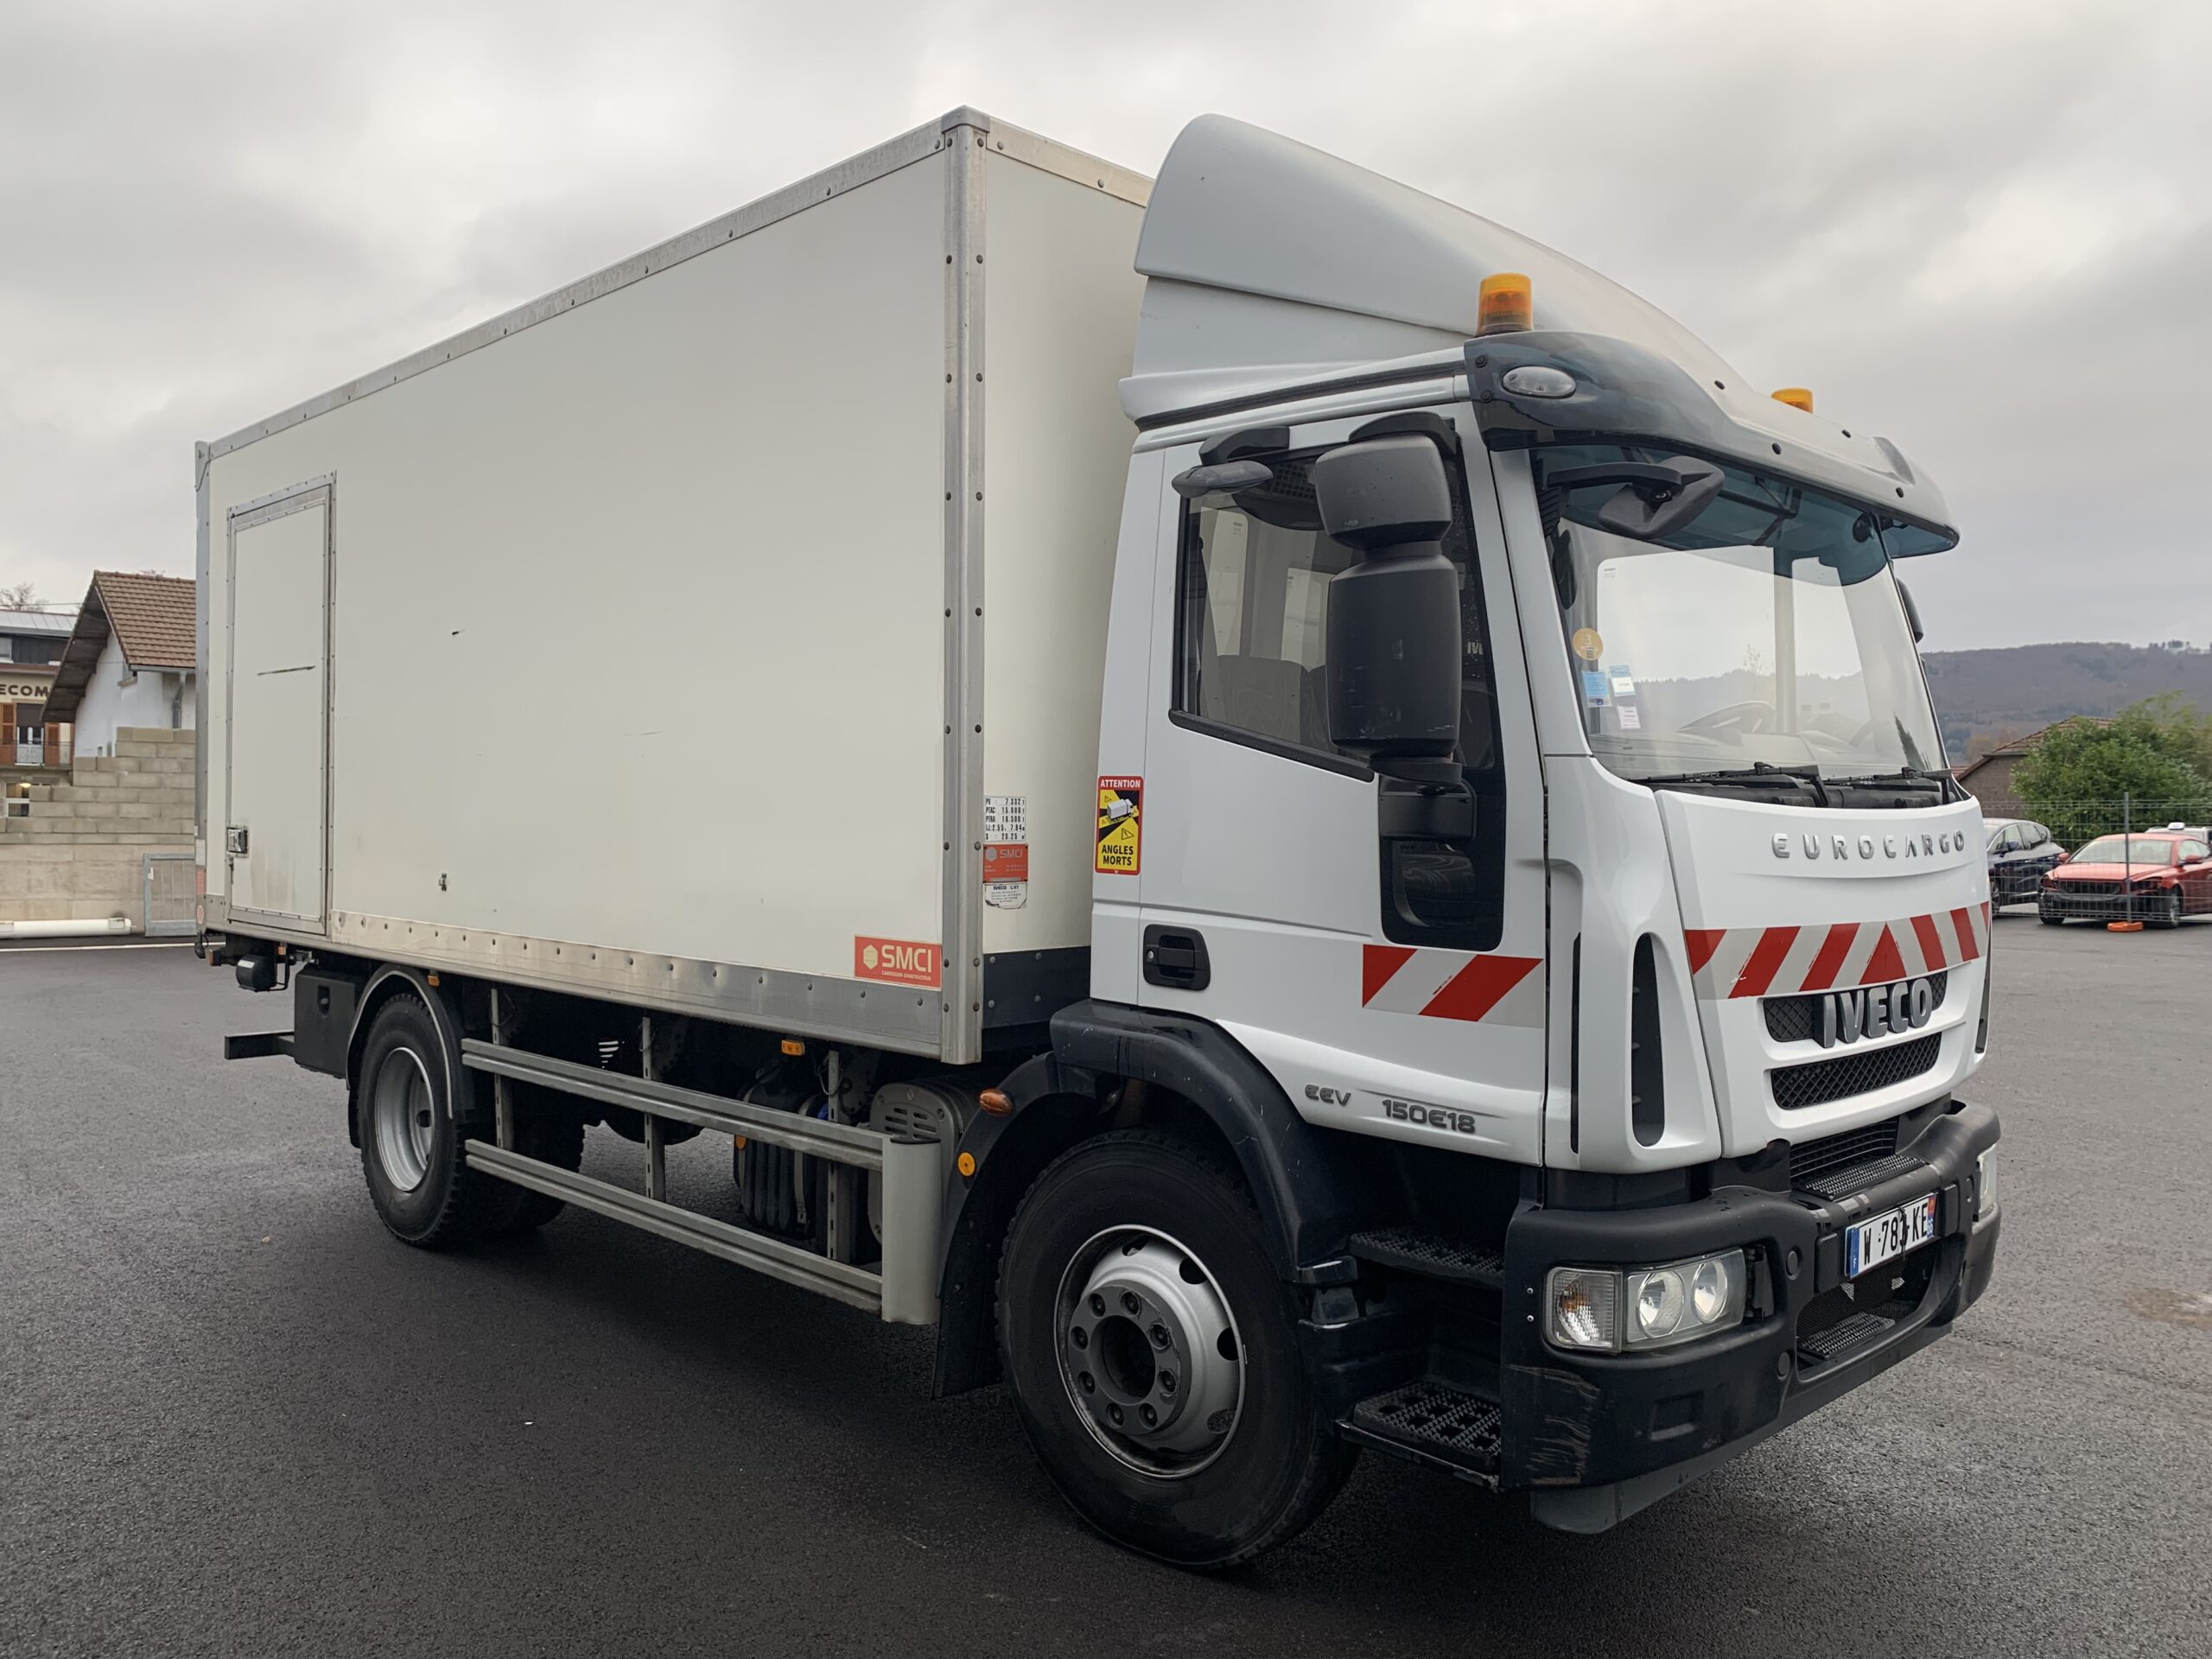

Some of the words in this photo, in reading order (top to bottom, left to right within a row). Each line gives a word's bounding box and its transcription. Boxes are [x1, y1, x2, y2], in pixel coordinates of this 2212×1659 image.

[1100, 779, 1141, 788] ATTENTION
[1000, 849, 1023, 858] SMCI
[1102, 844, 1134, 855] ANGLES
[1772, 830, 1965, 860] EUROCARGO
[1103, 855, 1132, 866] MORTS
[881, 944, 932, 973] SMCI
[1821, 977, 1933, 1049] IVECO
[1304, 1084, 1351, 1107] EEV
[1382, 1098, 1476, 1135] 150E18
